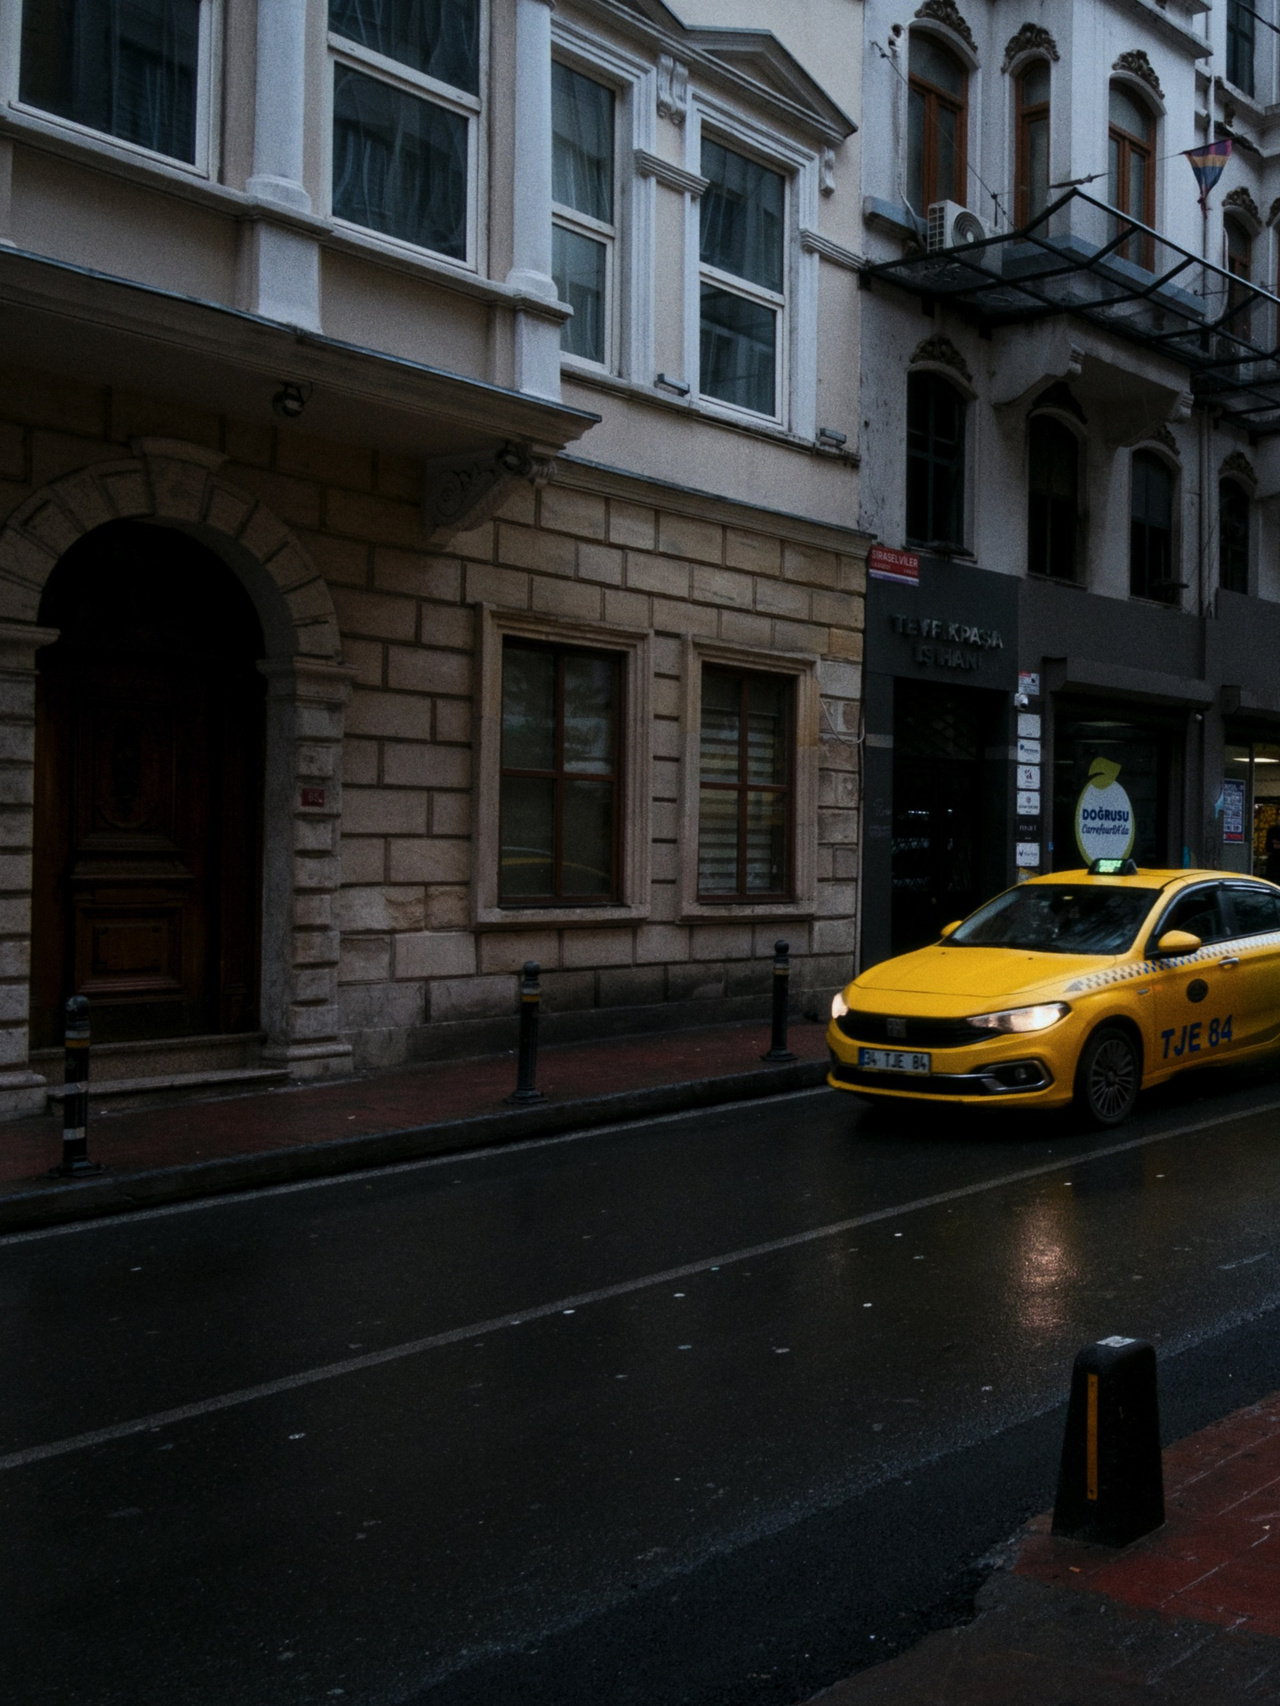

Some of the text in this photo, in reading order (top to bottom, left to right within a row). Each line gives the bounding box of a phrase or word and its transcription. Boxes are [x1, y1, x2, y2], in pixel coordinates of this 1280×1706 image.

[1082, 806, 1129, 822] DOĞRUSU
[1161, 1014, 1233, 1058] TJE 84
[865, 1051, 926, 1070] 34 TJE 84
